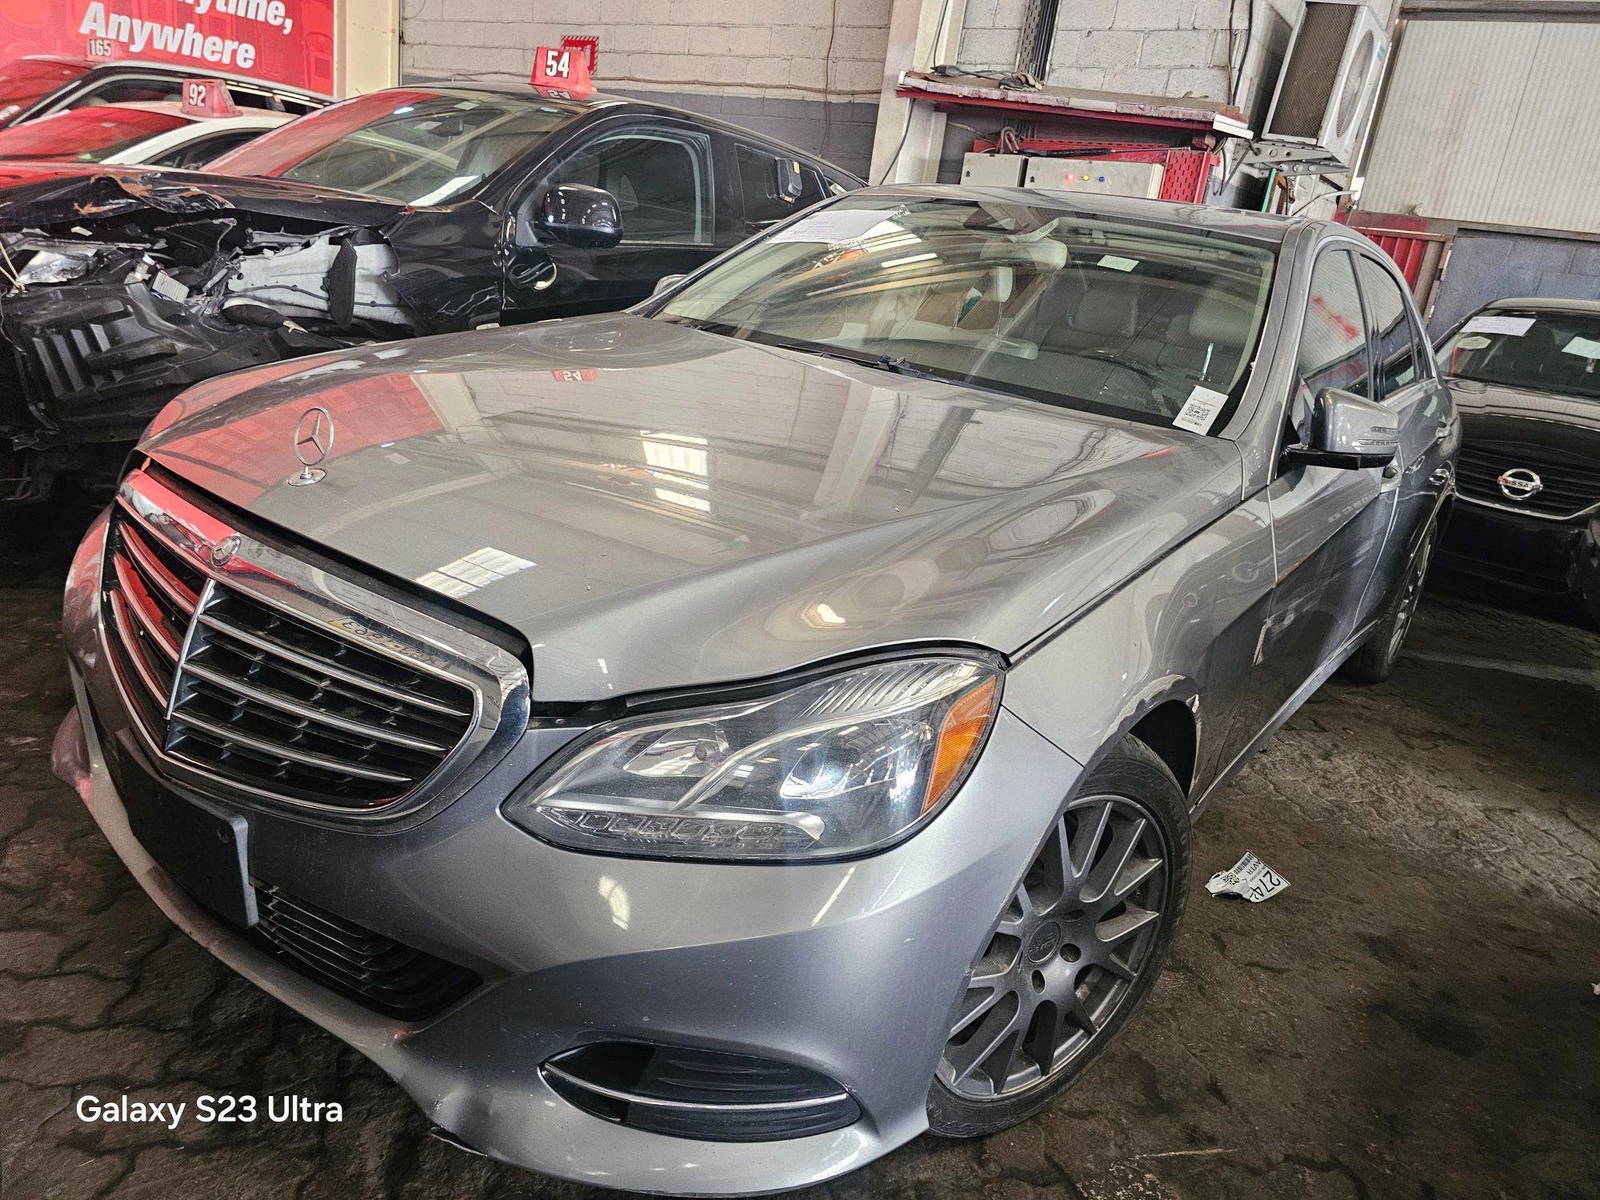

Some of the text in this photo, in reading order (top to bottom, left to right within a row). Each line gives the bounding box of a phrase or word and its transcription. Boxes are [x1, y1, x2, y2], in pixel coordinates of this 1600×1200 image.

[79, 1, 256, 68] Anywhere
[89, 39, 112, 57] 165
[545, 50, 570, 78] 54
[189, 84, 207, 107] 92
